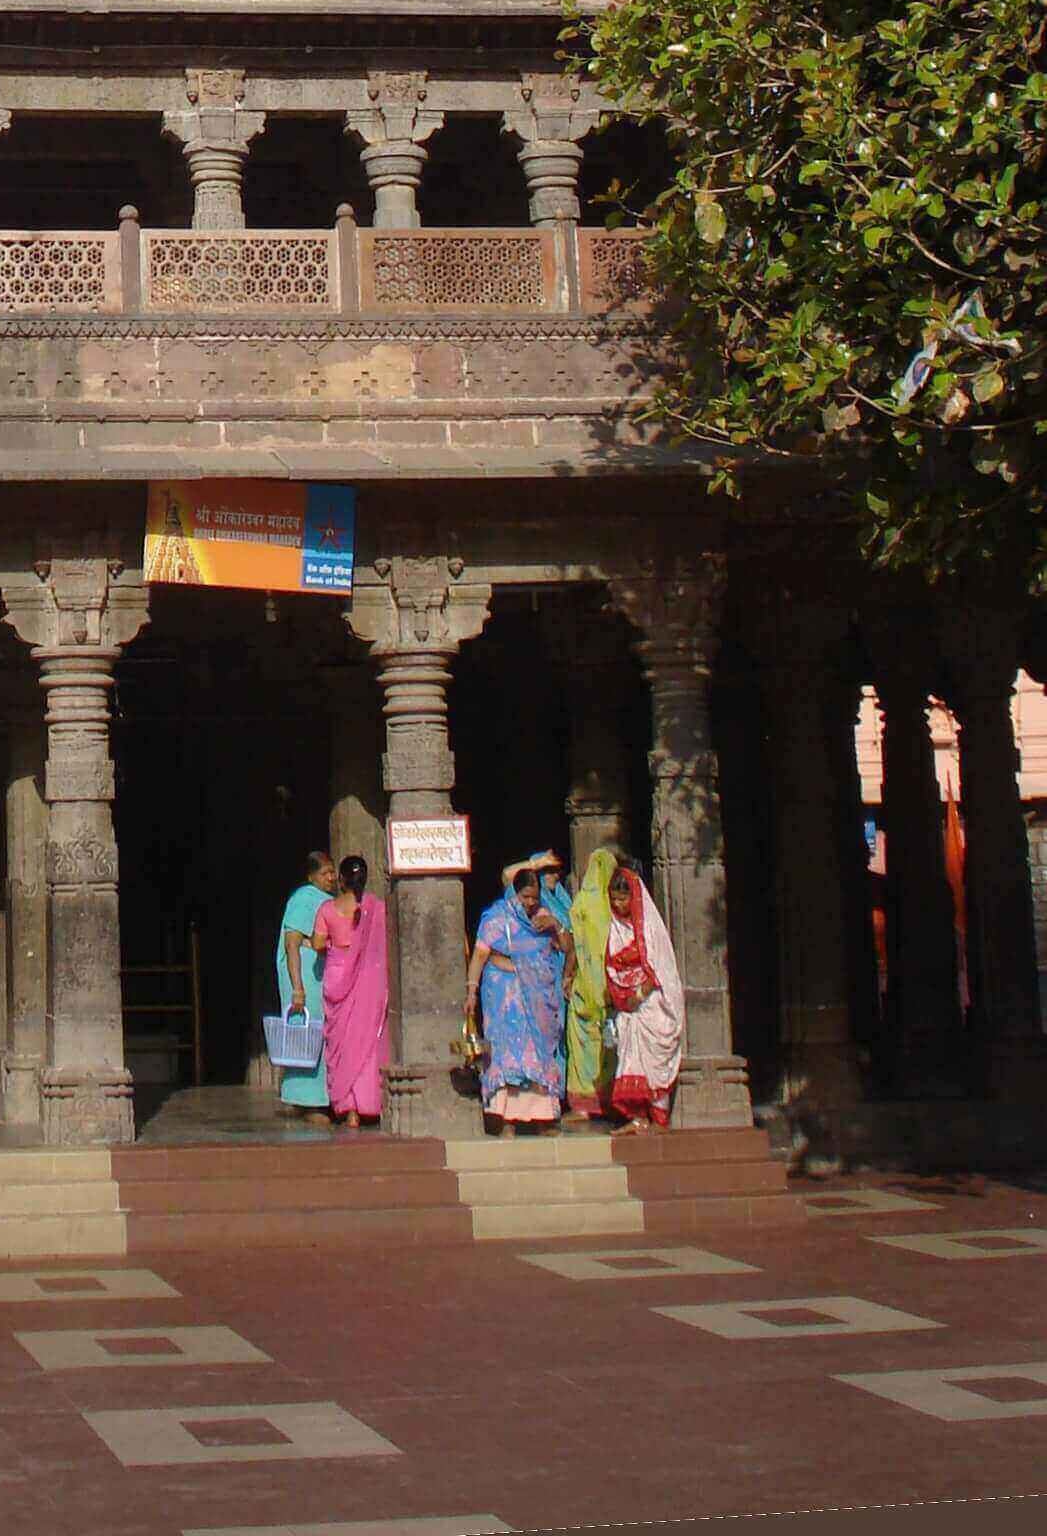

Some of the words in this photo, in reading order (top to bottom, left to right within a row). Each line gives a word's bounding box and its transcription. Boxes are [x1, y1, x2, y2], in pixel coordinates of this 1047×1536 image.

[306, 576, 323, 584] Bank
[325, 576, 333, 584] of
[334, 577, 352, 586] India
